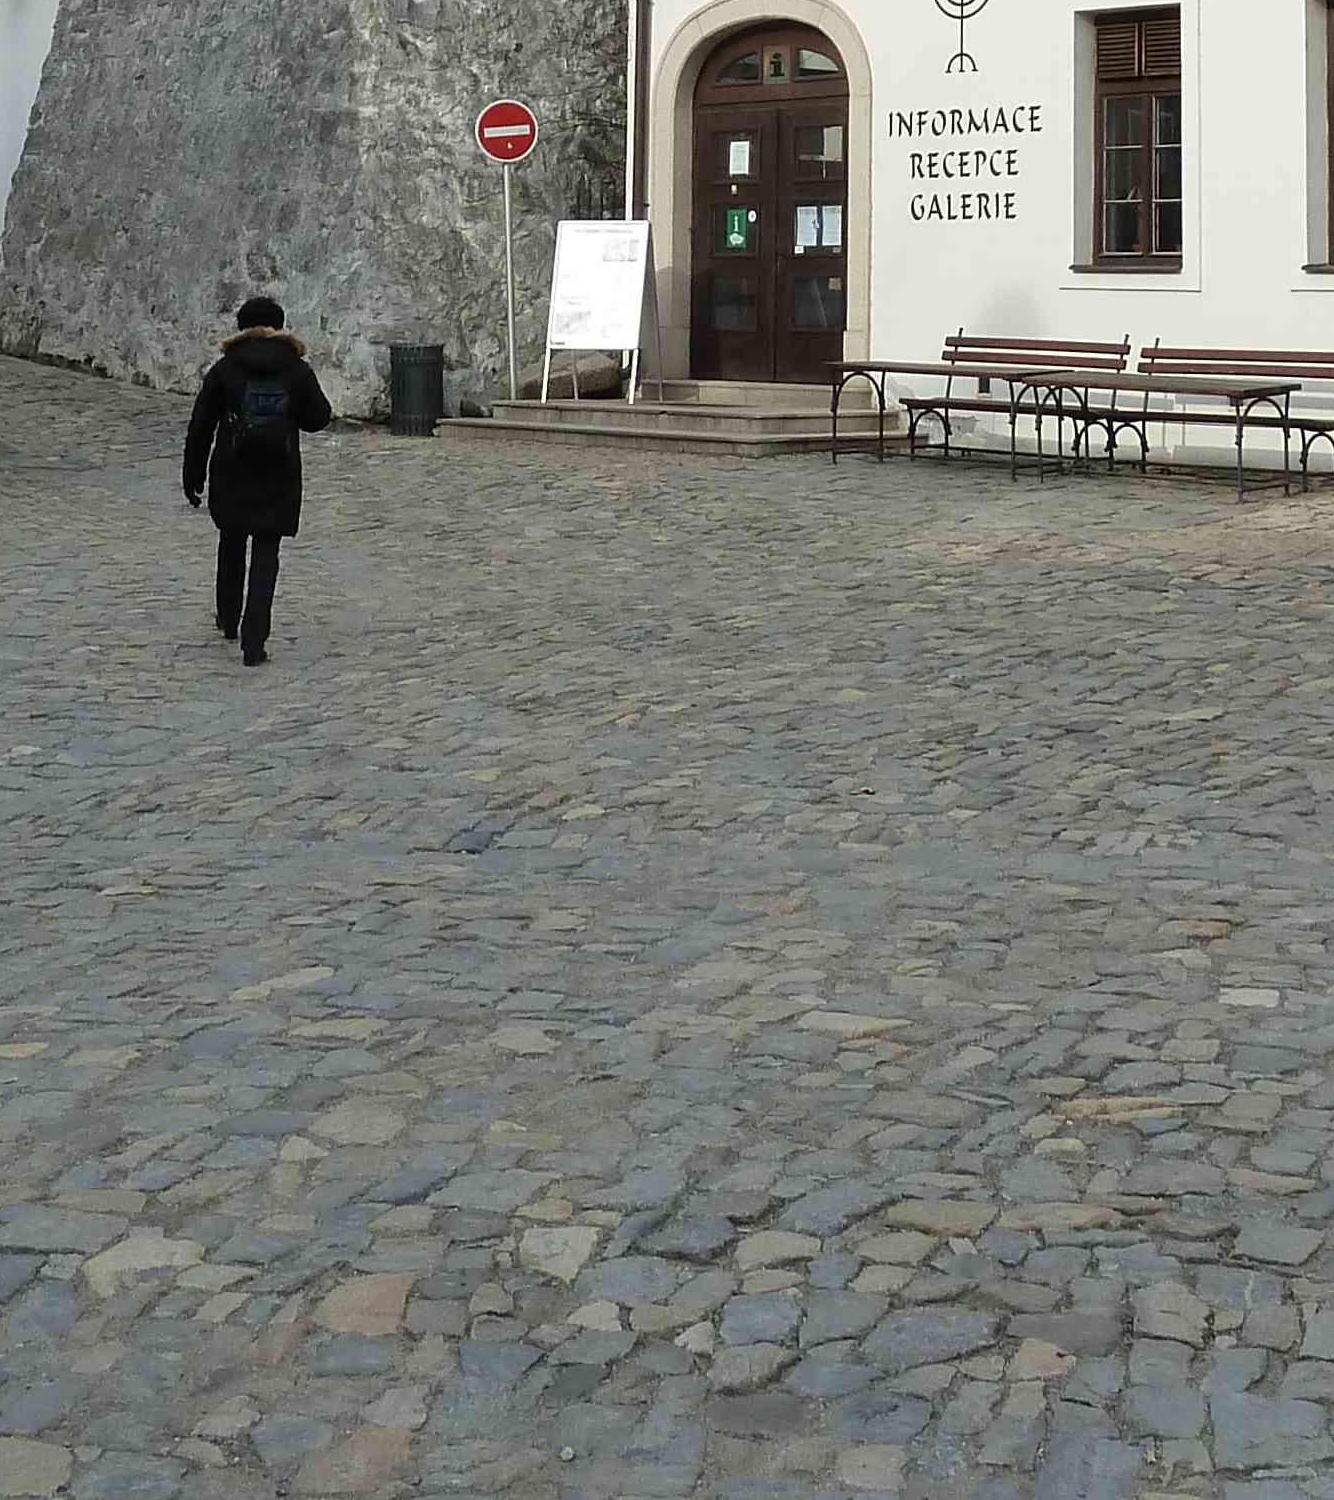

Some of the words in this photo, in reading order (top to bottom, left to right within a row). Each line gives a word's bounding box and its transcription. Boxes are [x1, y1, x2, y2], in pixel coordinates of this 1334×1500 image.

[888, 105, 1043, 138] INFORMACE
[910, 149, 1020, 180] RECEPCE
[910, 192, 1018, 222] GALERIE
